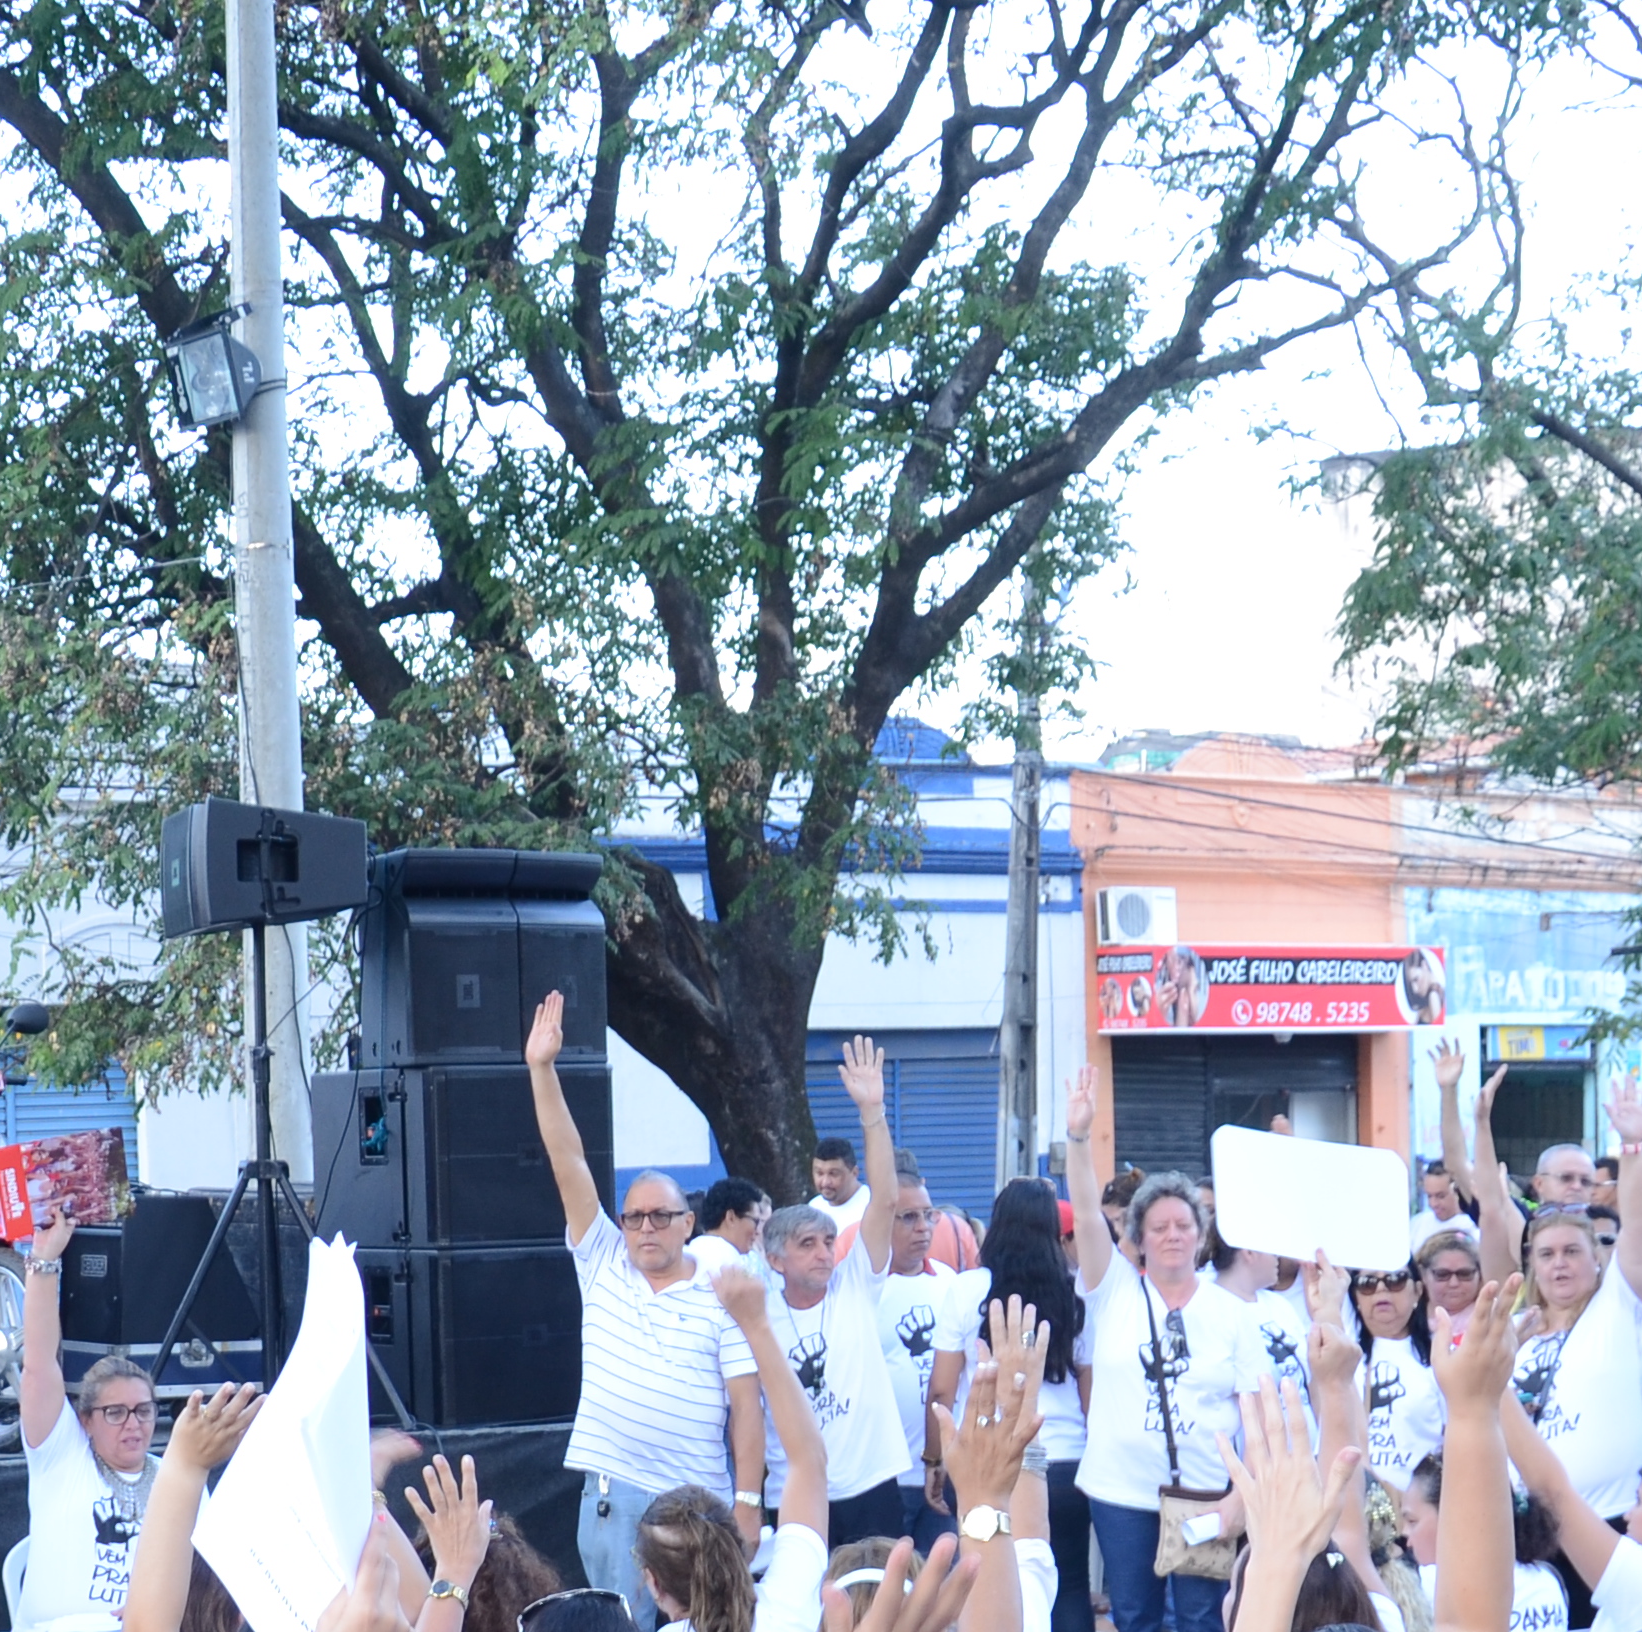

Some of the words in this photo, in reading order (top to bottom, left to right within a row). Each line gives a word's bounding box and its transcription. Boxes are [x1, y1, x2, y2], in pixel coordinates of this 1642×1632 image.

[1208, 956, 1247, 983] JOSÉ
[1249, 960, 1294, 984] FILHO
[1295, 958, 1400, 984] CABELEIREIRO
[1256, 1002, 1312, 1024] 98748
[1326, 1002, 1370, 1024] 5235
